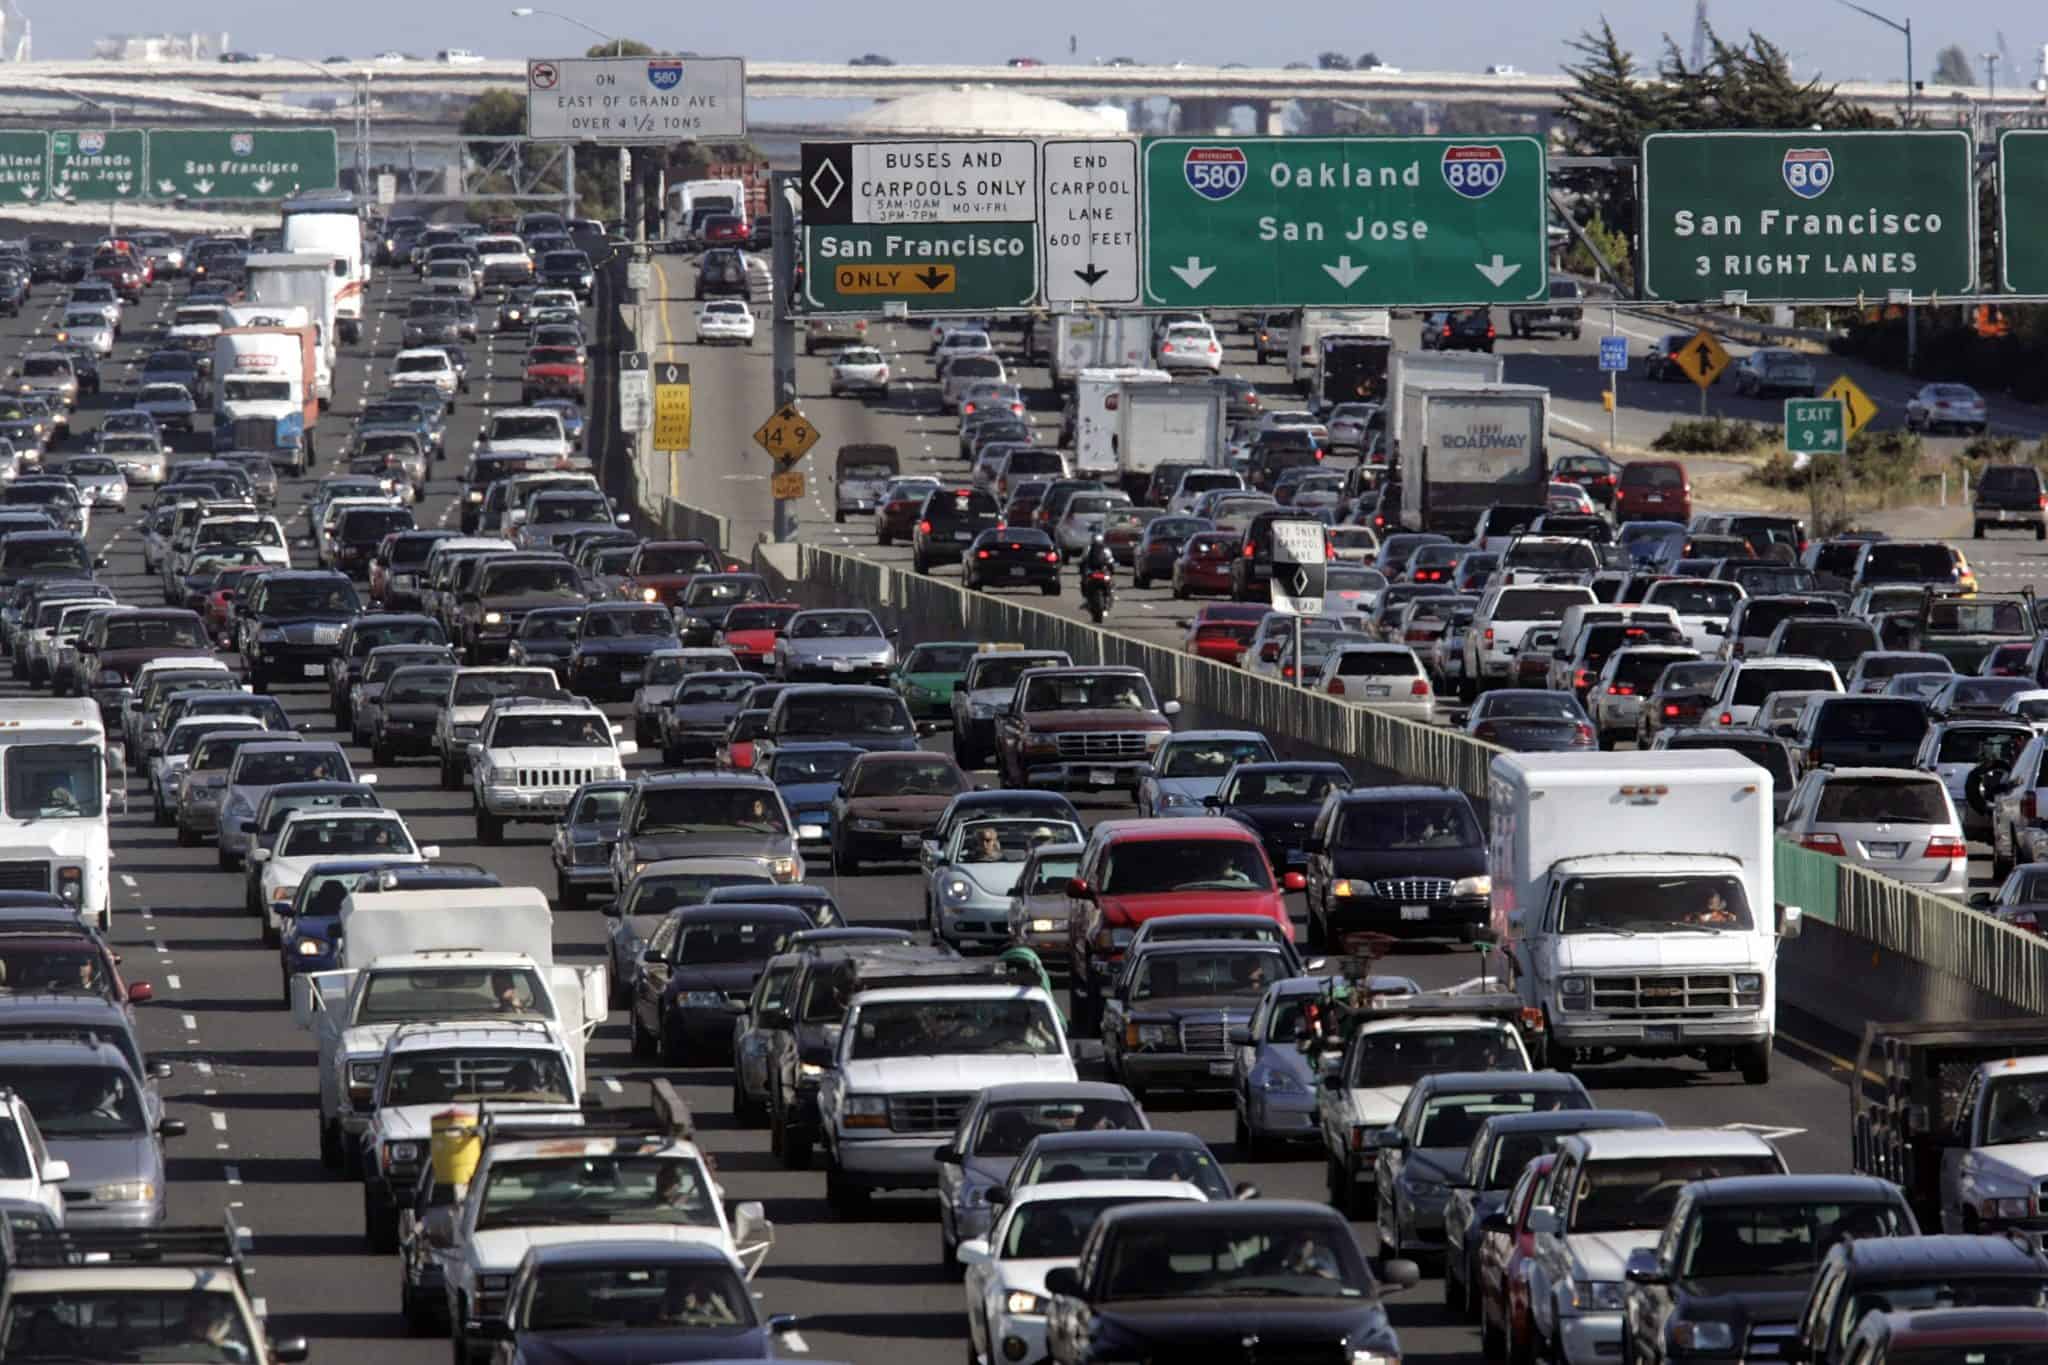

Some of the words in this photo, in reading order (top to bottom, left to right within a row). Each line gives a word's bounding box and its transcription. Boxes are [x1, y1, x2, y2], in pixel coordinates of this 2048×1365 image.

[596, 74, 616, 86] ON
[654, 71, 677, 83] 580
[558, 96, 592, 107] EAST
[603, 97, 619, 107] OF
[629, 96, 679, 107] GRAND
[689, 96, 716, 107] AVE
[572, 117, 610, 129] OVER
[664, 117, 701, 128] TONS
[185, 160, 215, 174] San
[221, 160, 299, 174] Francisco
[886, 152, 951, 168] BUSES
[962, 152, 1003, 168] AND
[1073, 156, 1108, 168] END
[61, 169, 89, 181] San
[97, 169, 133, 181] Jose
[1194, 165, 1240, 189] 580
[1271, 161, 1421, 187] Oakland
[1449, 163, 1499, 187] 880
[1789, 163, 1829, 187] 80
[861, 181, 967, 197] CARPOOLS
[977, 180, 1026, 196] ONLY
[1050, 182, 1130, 194] CARPOOL
[1068, 208, 1113, 220] LANE
[1674, 210, 1741, 236] San
[1761, 208, 1942, 236] Francisco
[1259, 217, 1324, 241] San
[1346, 217, 1428, 241] Jose
[820, 236, 873, 257] San
[886, 235, 1024, 257] Francisco
[1049, 233, 1081, 246] 600
[1092, 232, 1133, 246] FEET
[1696, 256, 1711, 276] 3
[1725, 255, 1811, 275] RIGHT
[1825, 253, 1917, 273] LANES
[840, 271, 901, 287] ONLY
[1796, 407, 1833, 422] EXIT
[1442, 433, 1527, 449] ROADWAY
[1803, 429, 1814, 446] 9
